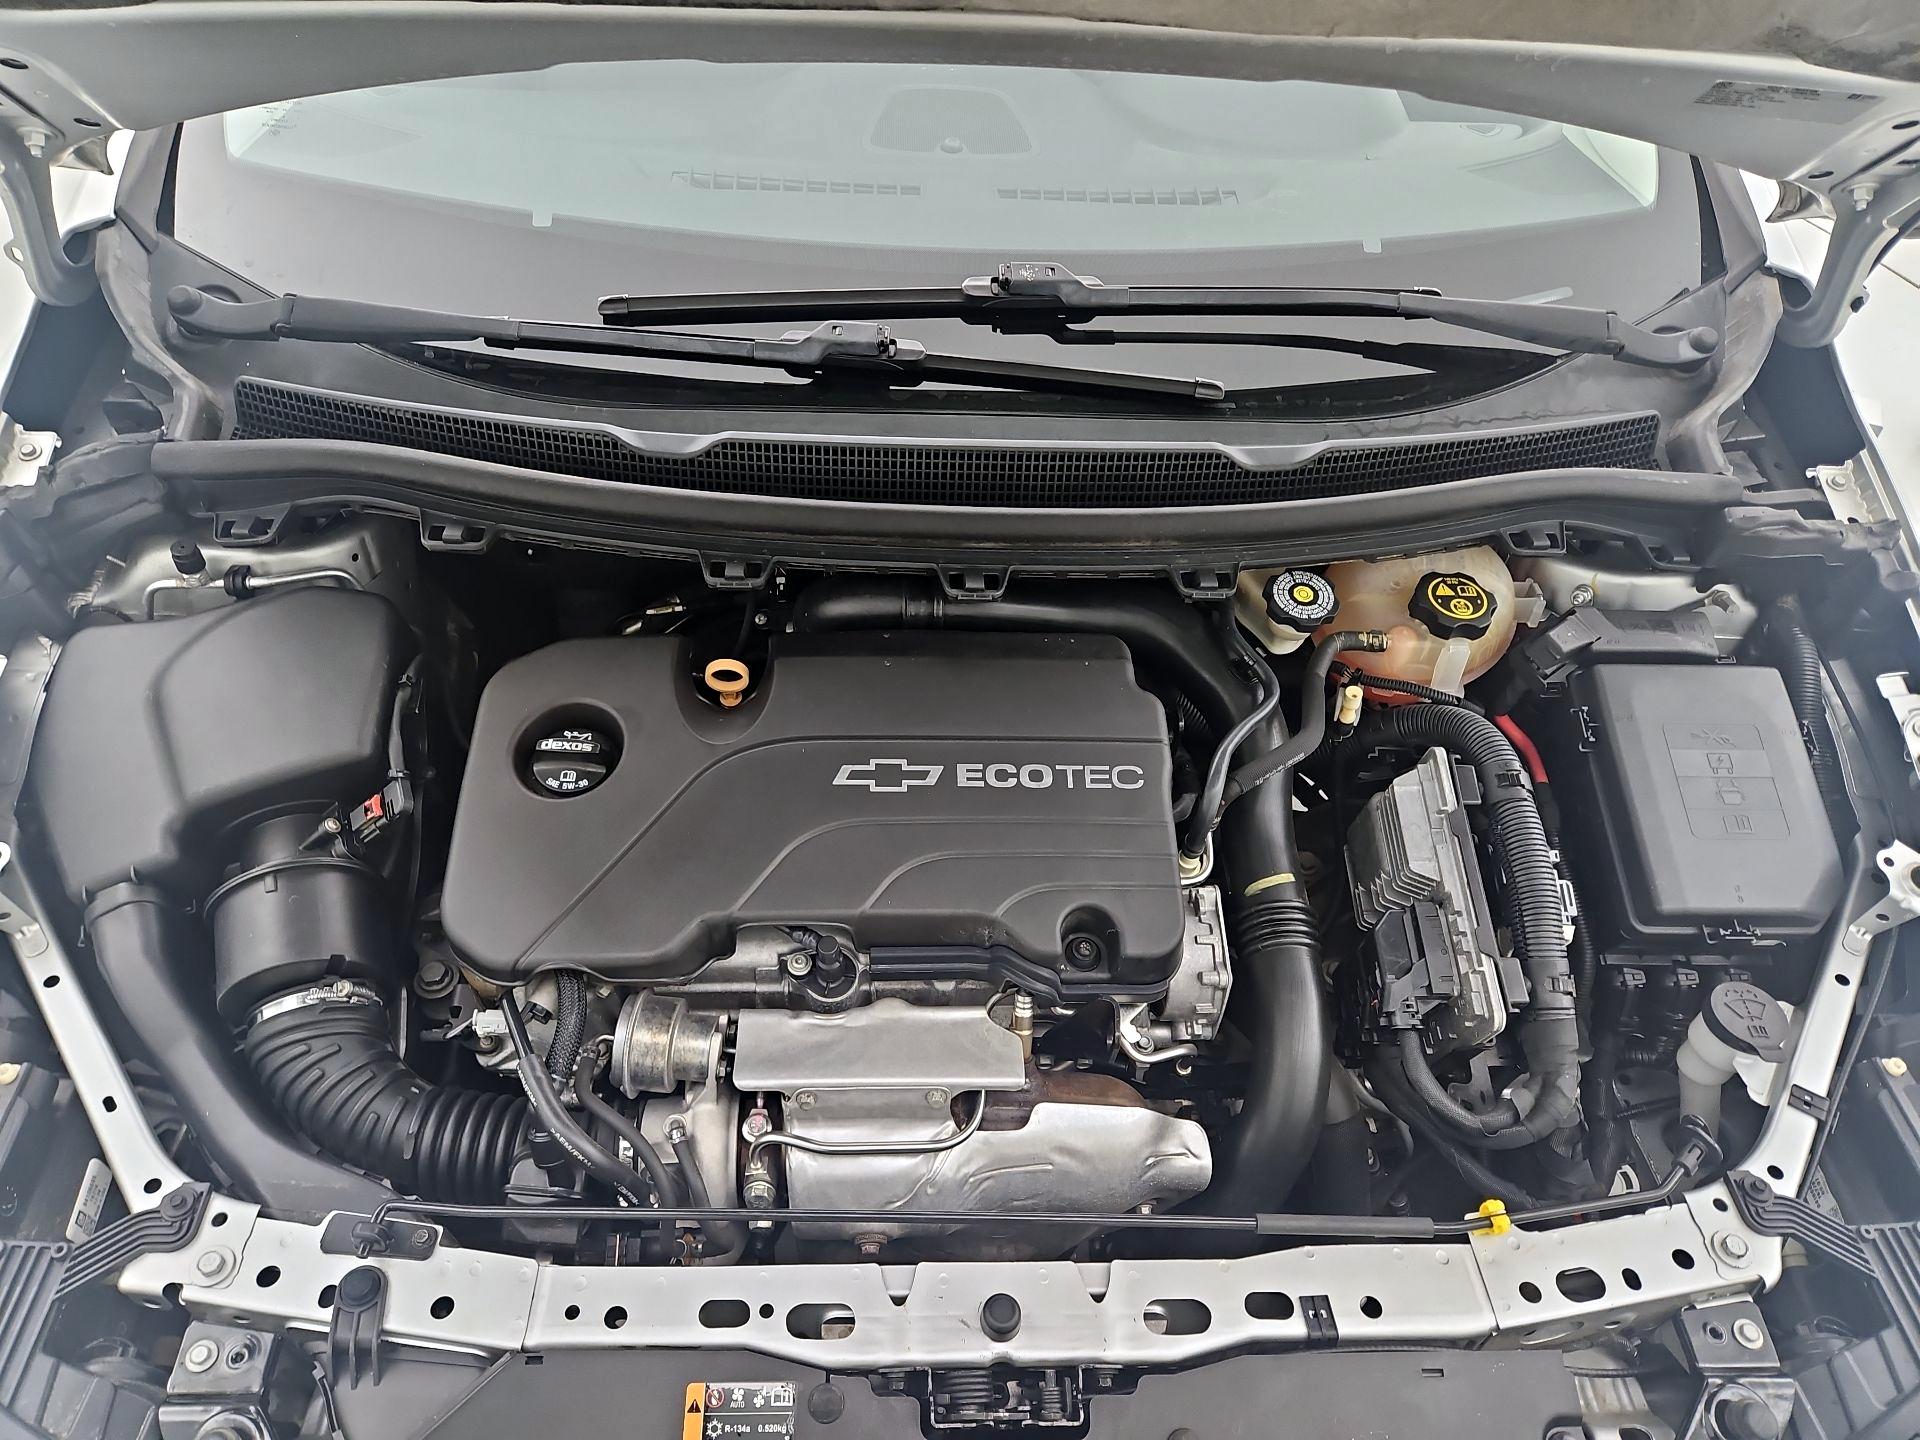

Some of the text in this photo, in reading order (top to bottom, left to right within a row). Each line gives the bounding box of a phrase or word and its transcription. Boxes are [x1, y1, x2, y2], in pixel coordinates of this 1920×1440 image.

[541, 738, 594, 752] dexos
[956, 763, 1145, 790] ECOTEC
[545, 777, 589, 790] SAE 5W-30
[730, 1400, 745, 1408] AUTO
[724, 1424, 751, 1433] R-134a
